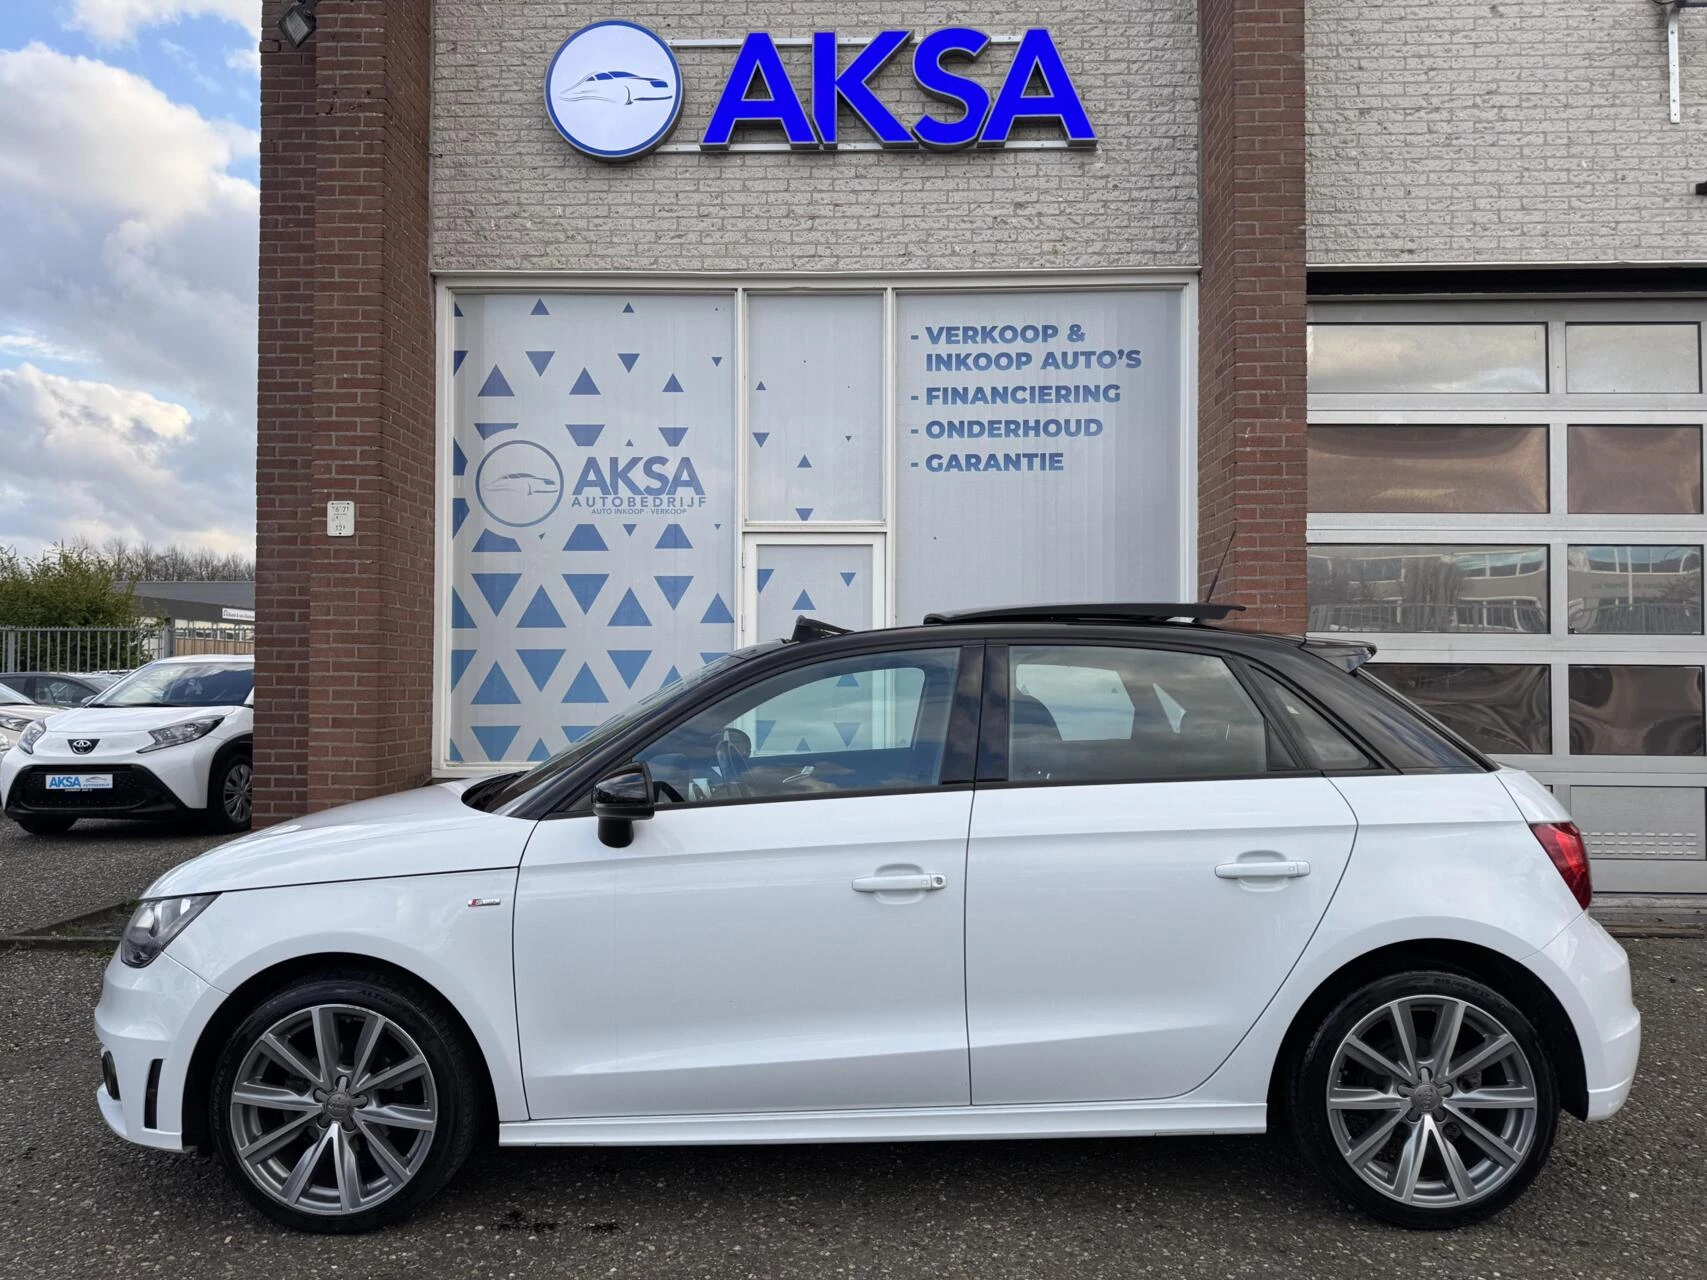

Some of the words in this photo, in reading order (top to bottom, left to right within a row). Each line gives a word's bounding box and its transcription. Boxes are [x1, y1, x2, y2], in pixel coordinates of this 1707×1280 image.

[702, 27, 1096, 147] AKSA
[925, 324, 1059, 345] VERKOOP
[1066, 323, 1086, 343] &
[925, 352, 1033, 372] INKOOP
[1040, 349, 1142, 370] AUTO'S
[925, 384, 1121, 405] FINANCIERING
[925, 419, 1104, 440] ONDERHOUD
[925, 452, 1065, 472] GARANTIE
[572, 456, 706, 496] AKSA
[571, 496, 707, 508] AUTOBEDRIJF
[49, 776, 82, 788] AKSA
